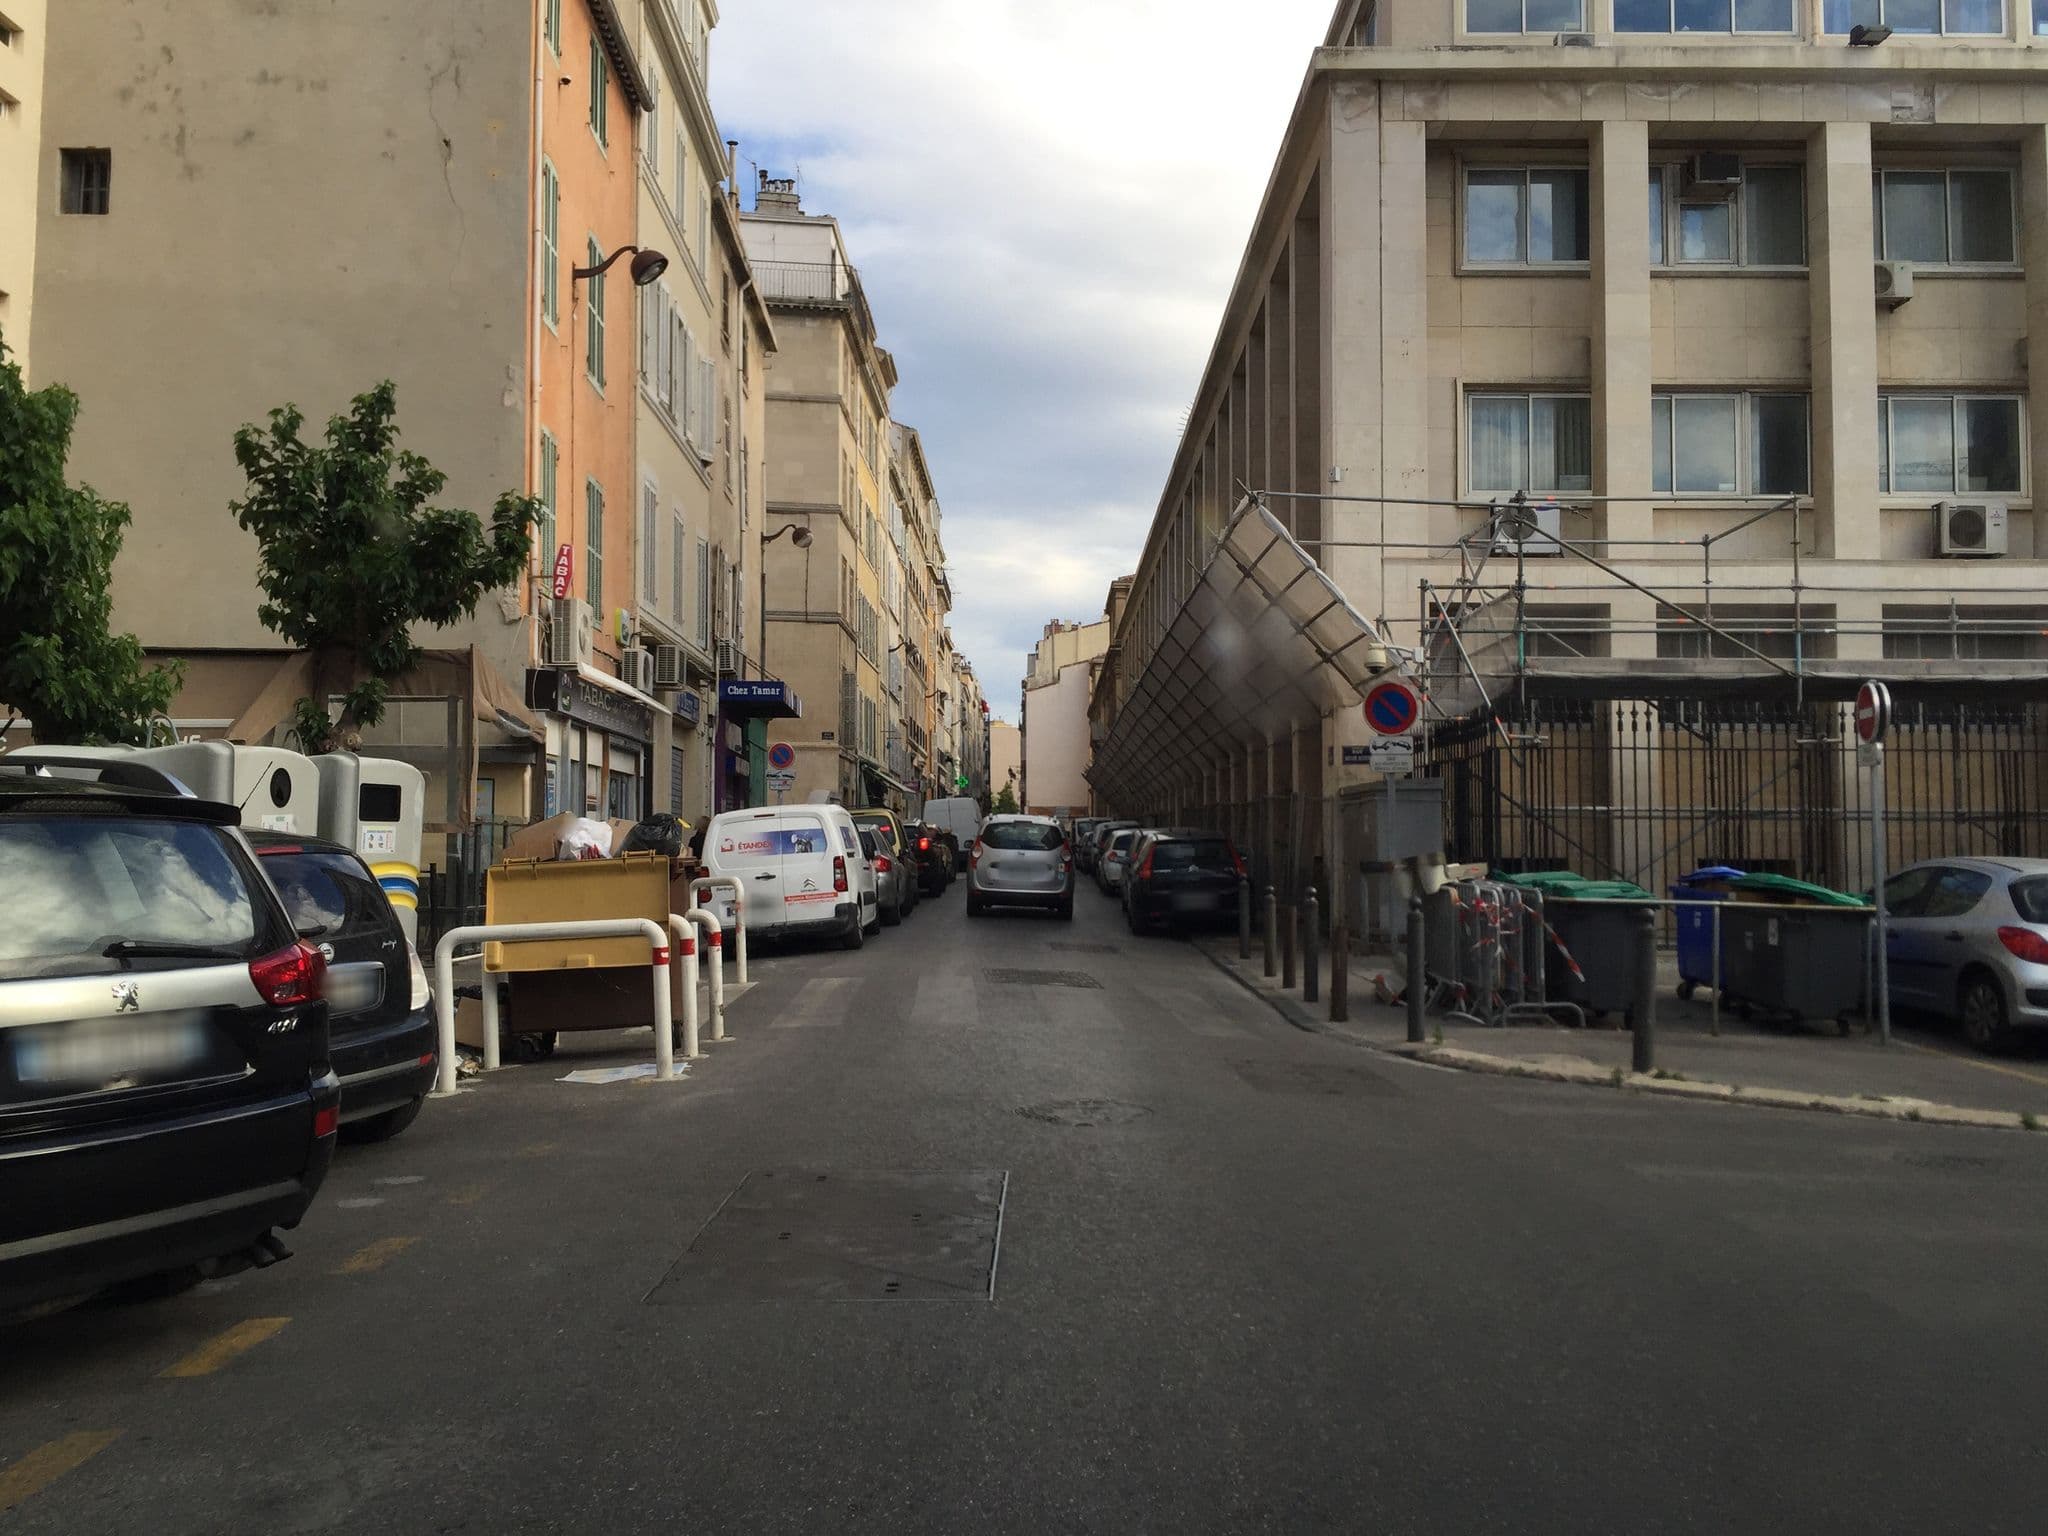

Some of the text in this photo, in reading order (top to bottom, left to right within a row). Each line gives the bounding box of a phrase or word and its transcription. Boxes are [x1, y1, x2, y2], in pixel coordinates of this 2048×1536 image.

[554, 546, 570, 596] TABAC
[578, 681, 611, 711] TABAC
[727, 685, 781, 696] Chez Tamar
